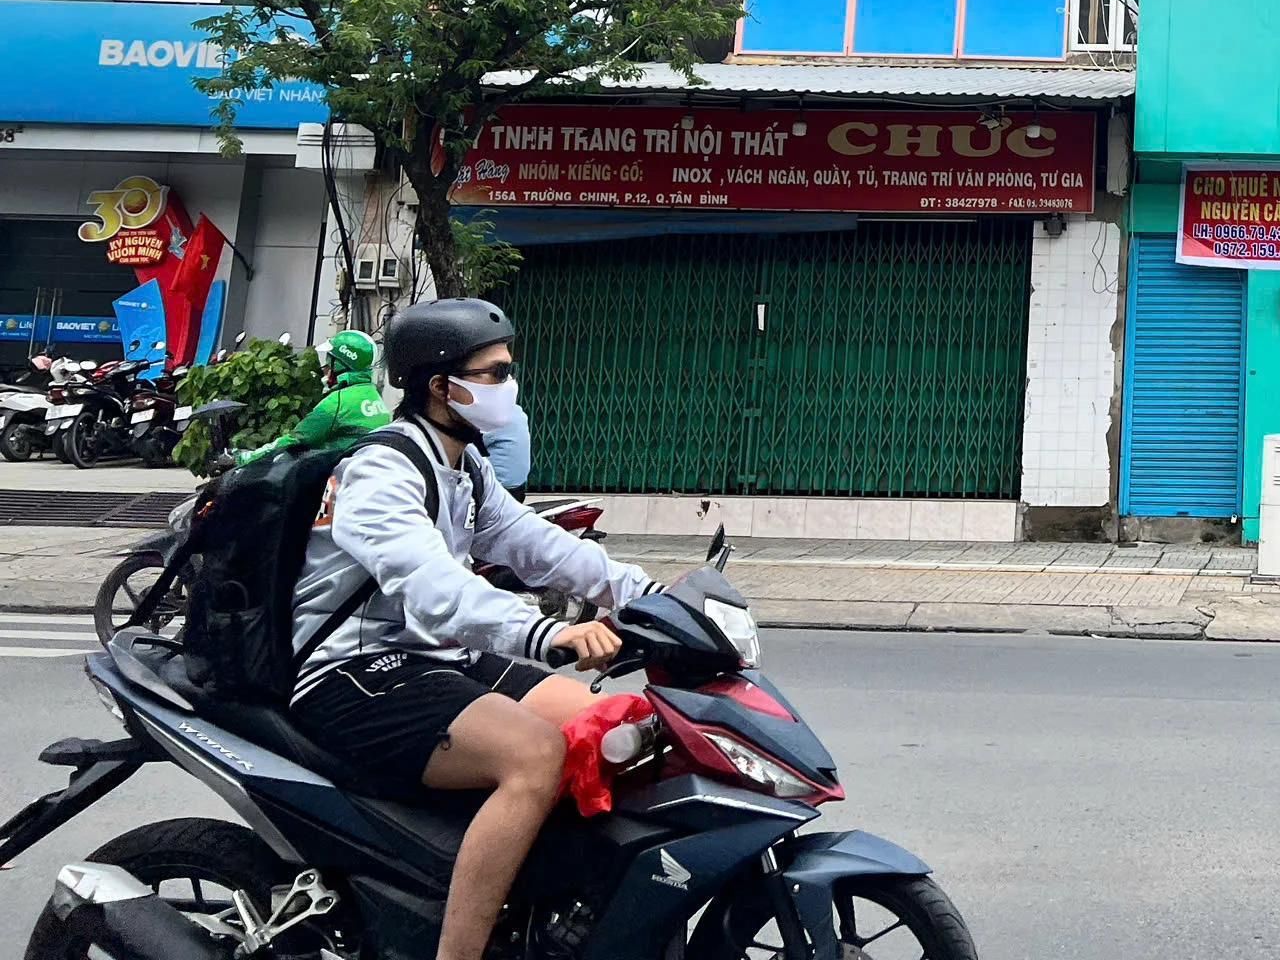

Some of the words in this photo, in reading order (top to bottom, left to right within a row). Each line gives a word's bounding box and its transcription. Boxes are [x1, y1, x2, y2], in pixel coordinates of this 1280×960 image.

[491, 126, 553, 151] TNHH
[561, 127, 636, 152] TRANG
[643, 123, 679, 154] TRÍ
[684, 124, 721, 161] NỘI
[731, 122, 789, 157] THẤT
[672, 167, 712, 184] INOX
[768, 166, 809, 188] NGĂN,
[883, 170, 928, 187] TRANG
[932, 167, 953, 187] TRÍ
[957, 166, 984, 188] VĂN
[987, 167, 1037, 190] PHÒNG,
[1041, 168, 1059, 188] TƯ
[1061, 171, 1084, 188] GIA
[1193, 177, 1225, 195] CHO
[1229, 173, 1268, 198] THUÊ
[488, 190, 516, 202] 156A
[523, 187, 572, 202] TRƯỜNG
[579, 191, 620, 204] CHINH,
[624, 192, 650, 205] P.12,
[700, 190, 728, 205] BÌNH
[945, 197, 998, 208] 38427978
[1201, 199, 1260, 221] NGUYÊN
[1193, 224, 1212, 239] LH:
[56, 322, 96, 330] BAOVIET
[338, 344, 358, 361] Grab
